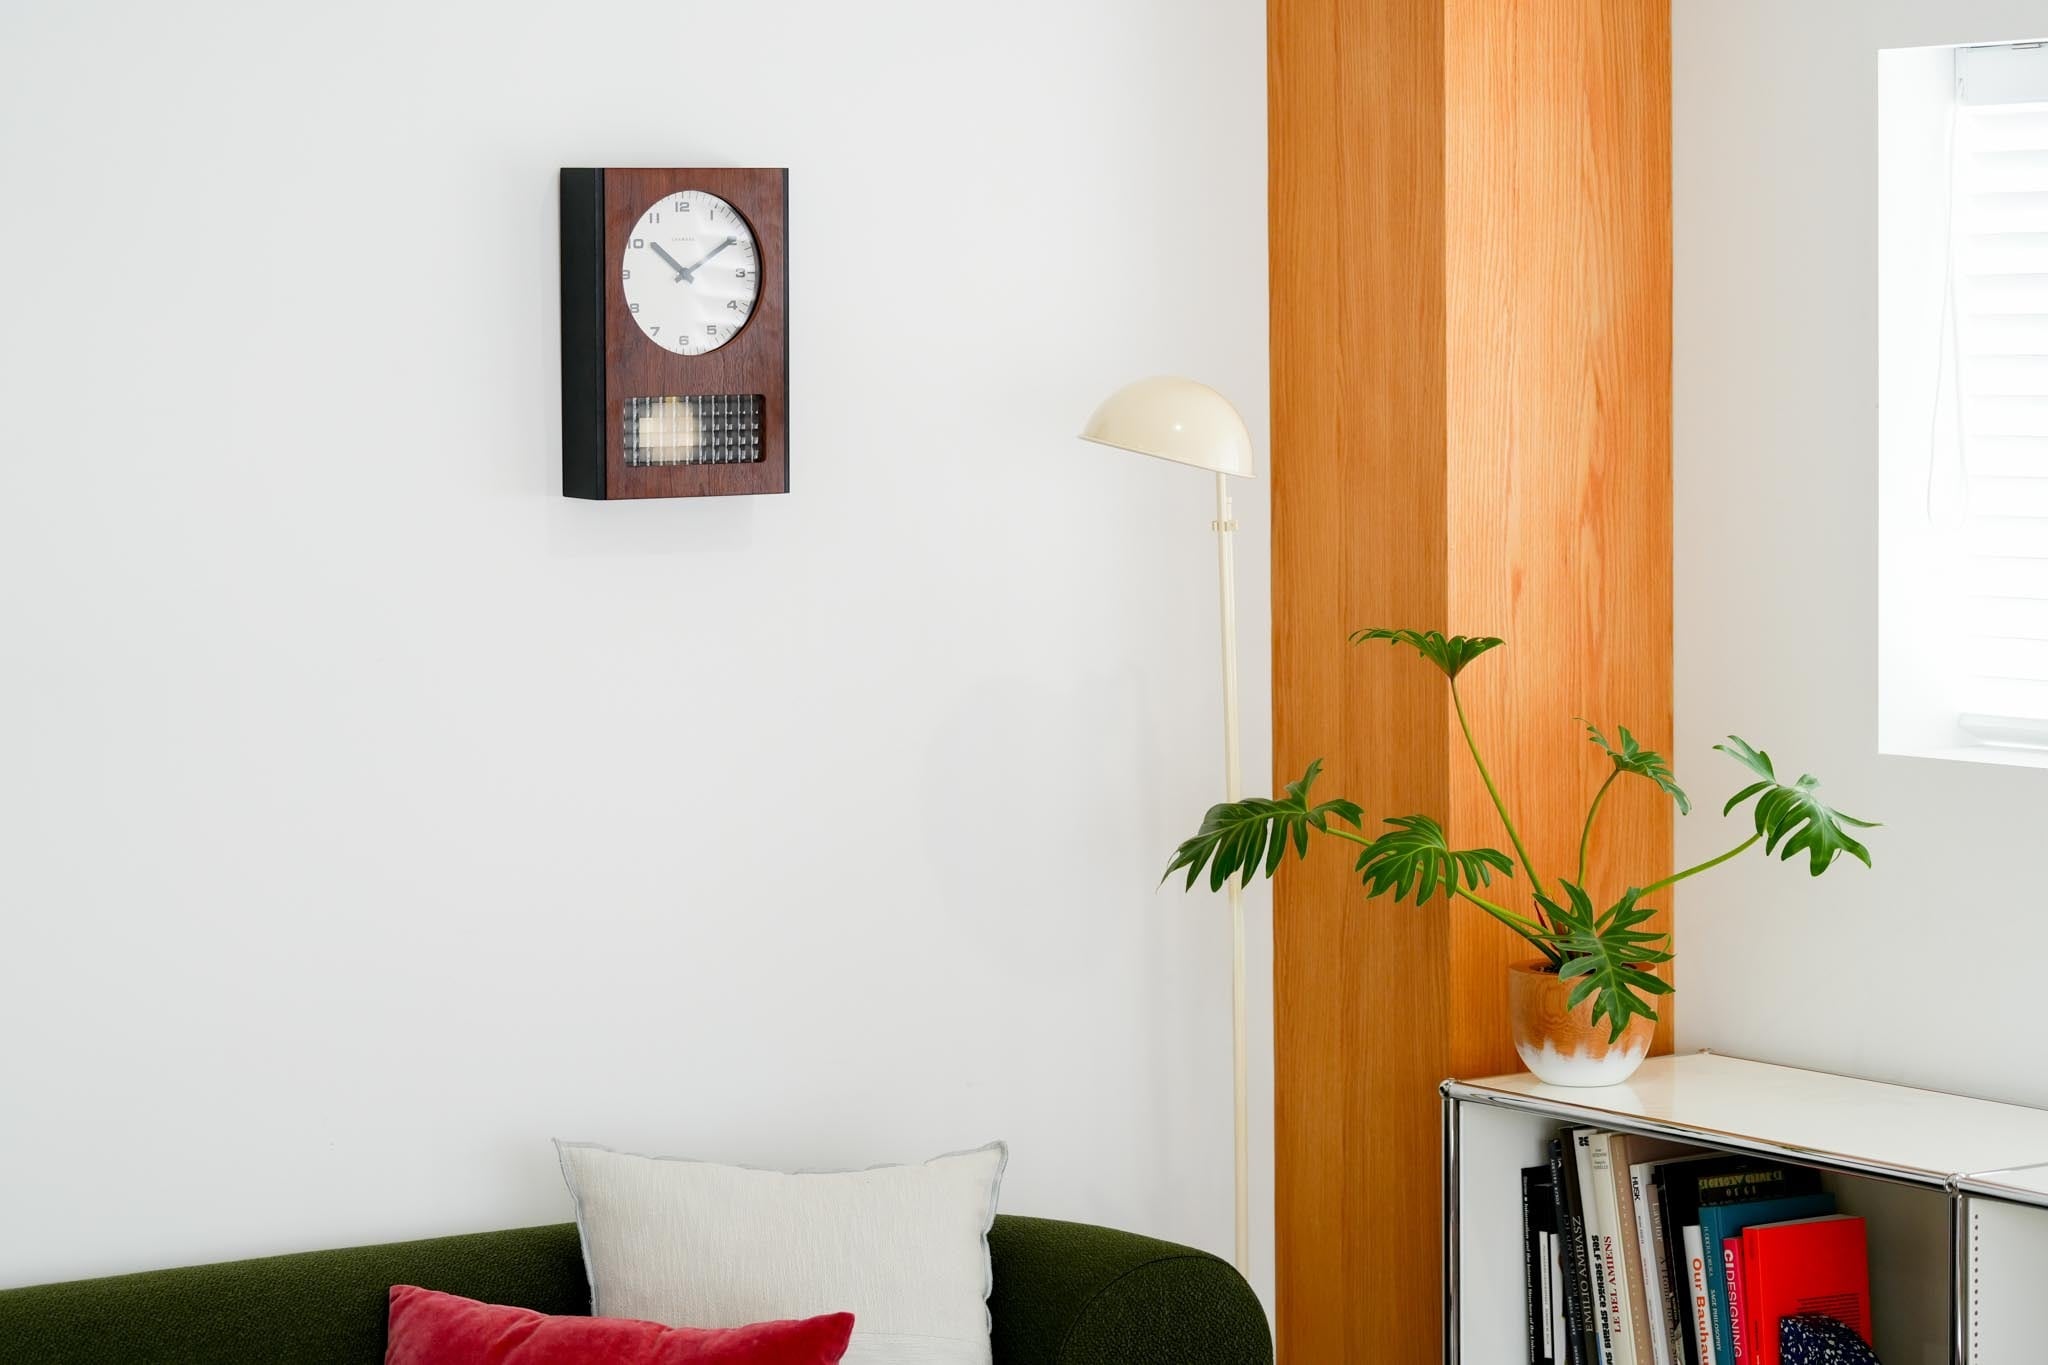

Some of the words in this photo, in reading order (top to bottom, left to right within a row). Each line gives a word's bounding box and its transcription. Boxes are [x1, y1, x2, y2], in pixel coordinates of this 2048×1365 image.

[675, 202, 690, 212] 12
[649, 213, 660, 224] 11
[710, 210, 714, 221] 1
[627, 239, 644, 249] 10
[735, 268, 746, 278] 3
[630, 303, 640, 314] 8
[726, 300, 738, 310] 4
[650, 326, 661, 337] 7
[706, 325, 717, 335] 5
[679, 335, 689, 346] 6
[1632, 1176, 1640, 1201] HUSK
[1652, 1202, 1663, 1241] Lawlor
[1572, 1216, 1588, 1277] AMBASZ
[1604, 1236, 1617, 1287] AMIENS
[1692, 1258, 1703, 1291] Our
[1579, 1280, 1593, 1332] EMILIO
[1610, 1288, 1619, 1313] BEL
[1613, 1316, 1621, 1333] LE
